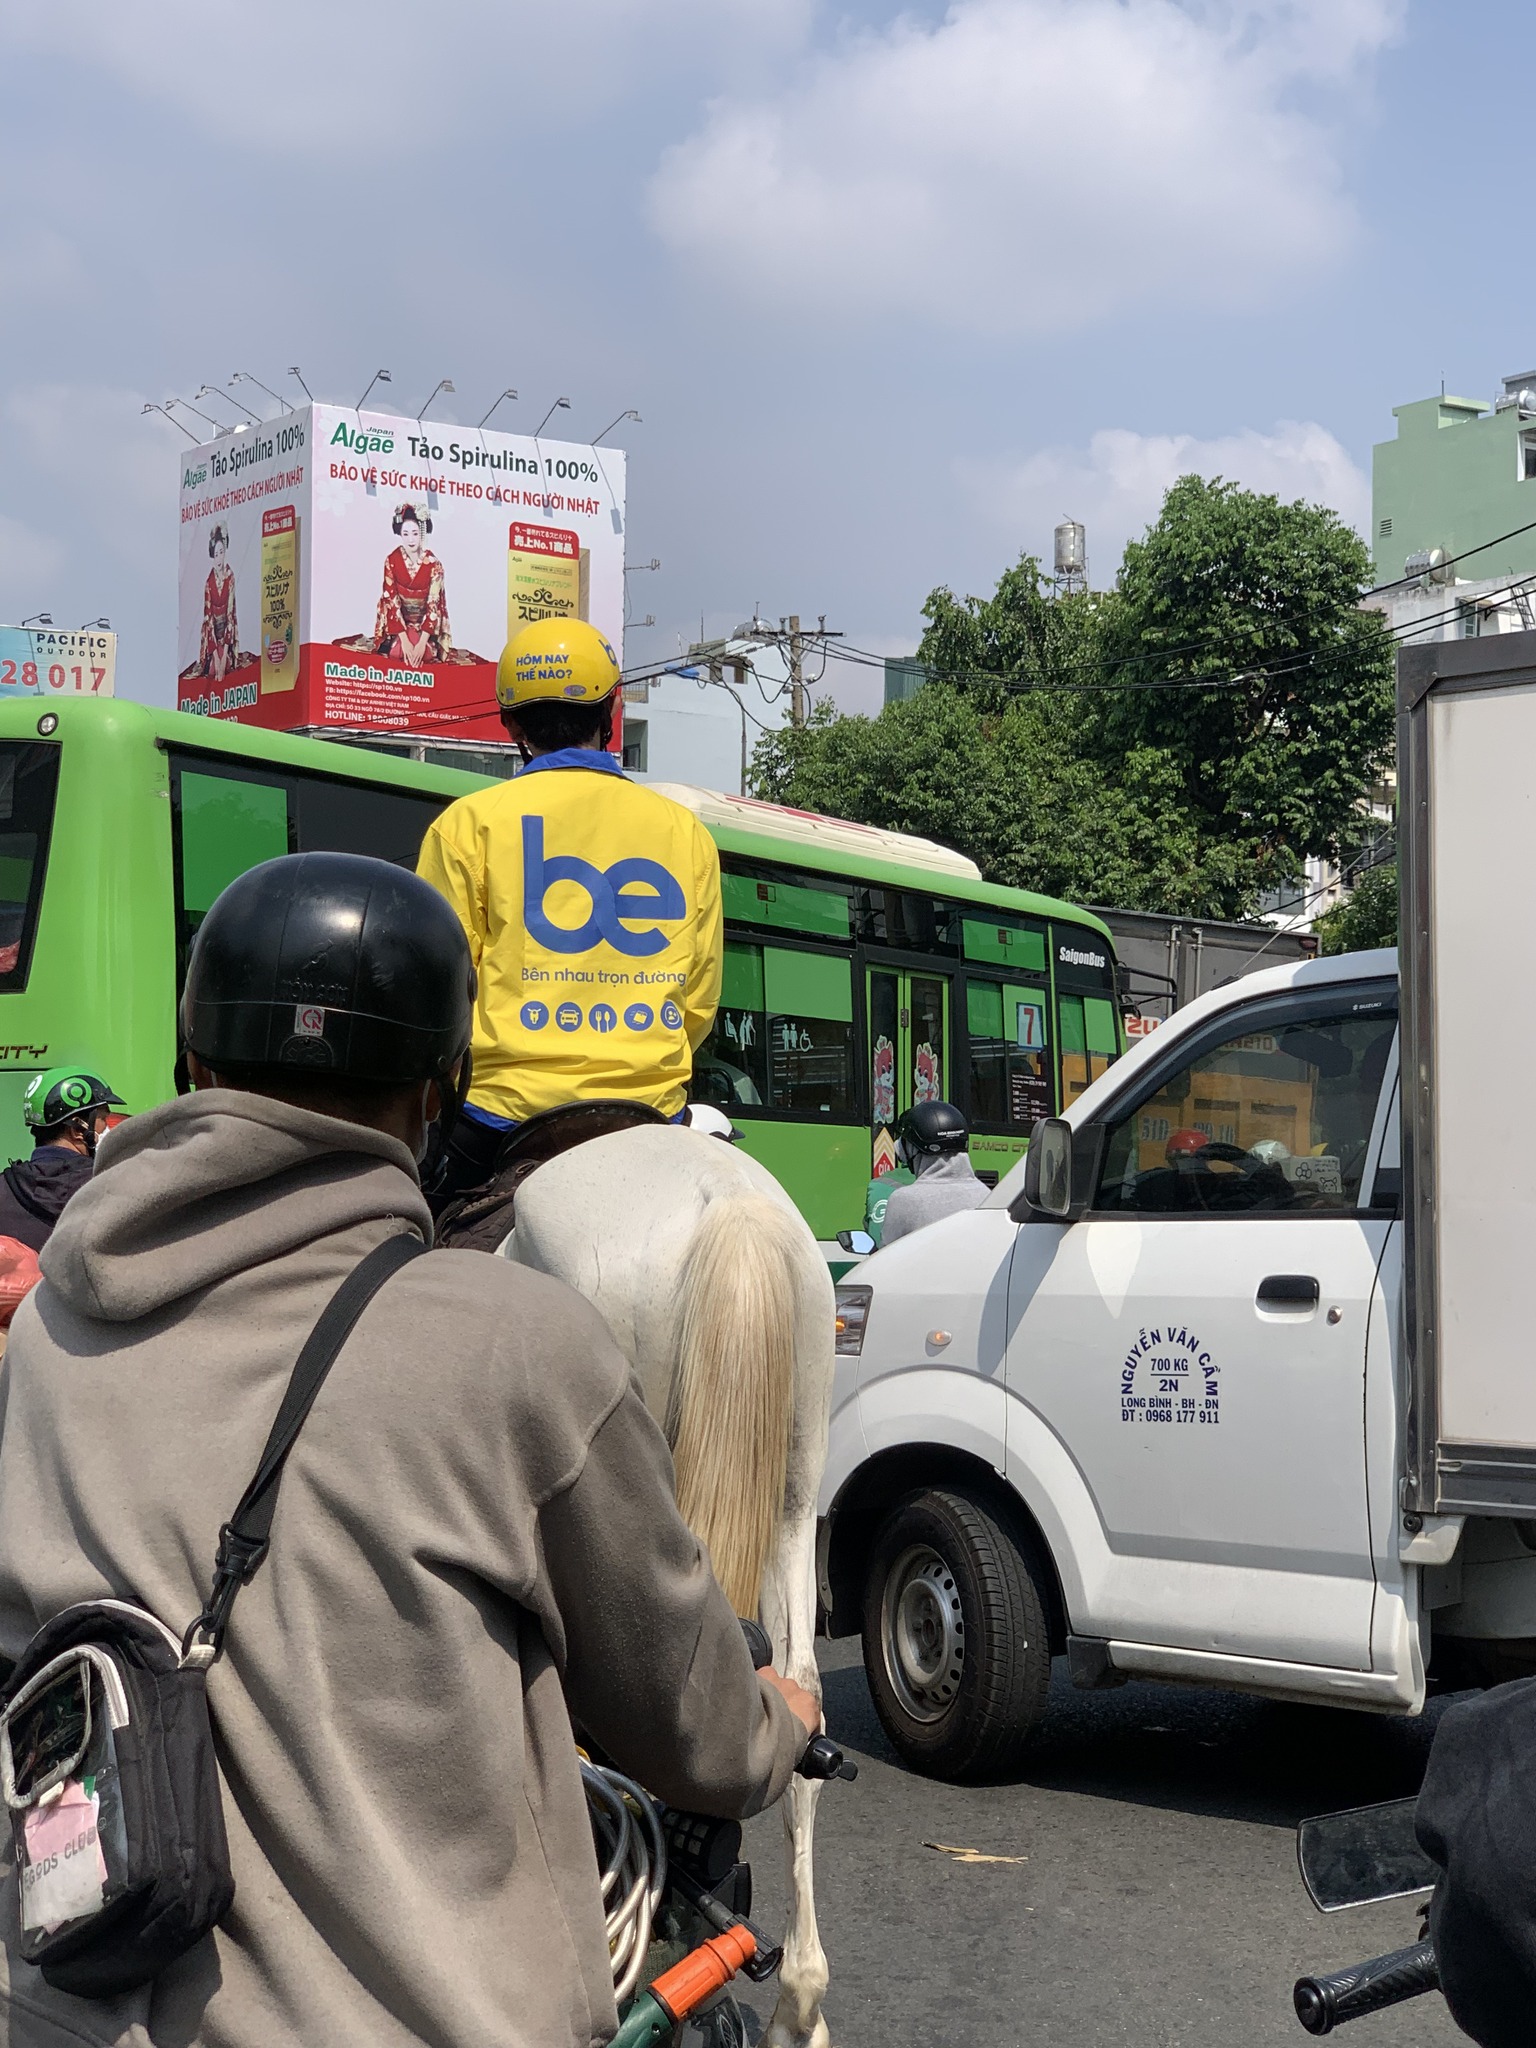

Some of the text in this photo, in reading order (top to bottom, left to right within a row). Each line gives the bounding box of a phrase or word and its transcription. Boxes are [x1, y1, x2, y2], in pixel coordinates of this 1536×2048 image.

[330, 422, 394, 454] Algae
[366, 426, 394, 436] Japan
[211, 423, 304, 478] Tảo Spirulina 100%
[407, 436, 598, 483] Tảo Spirulina 100%
[183, 468, 207, 490] Algae
[230, 488, 246, 508] THEO
[248, 481, 264, 501] CÁCH
[330, 462, 600, 517] BẢO VỆ SỨC KHOẺ THEO CÁCH NGƯỜI NHẬT
[37, 634, 106, 648] PACIFIC
[37, 647, 106, 658] OUTDOOR
[516, 654, 570, 666] HÔM NAY
[325, 662, 434, 688] Made in JAPAN
[326, 679, 352, 687] Website:
[516, 666, 572, 681] THẾ NÀO?
[181, 682, 258, 716] Made in JAPAN
[325, 710, 366, 721] HOTLINE:
[522, 815, 686, 957] be
[1060, 946, 1105, 968] SaigonBus
[522, 968, 686, 988] Bên nhau trọn đường
[1024, 1008, 1034, 1045] 7
[972, 1141, 1008, 1152] SAMCO
[1121, 1328, 1161, 1394] NGUYỄN
[1168, 1326, 1200, 1353] VĂN
[1151, 1358, 1188, 1371] 700 KG
[1159, 1379, 1178, 1392] 2N
[1121, 1398, 1146, 1408] LONG
[1149, 1395, 1172, 1408] BÌNH
[1182, 1399, 1195, 1408] BH
[1205, 1399, 1219, 1409] ĐN
[1122, 1409, 1135, 1422] ĐT
[1146, 1410, 1172, 1422] 0968
[1176, 1410, 1195, 1423] 177
[1199, 1411, 1219, 1423] 911
